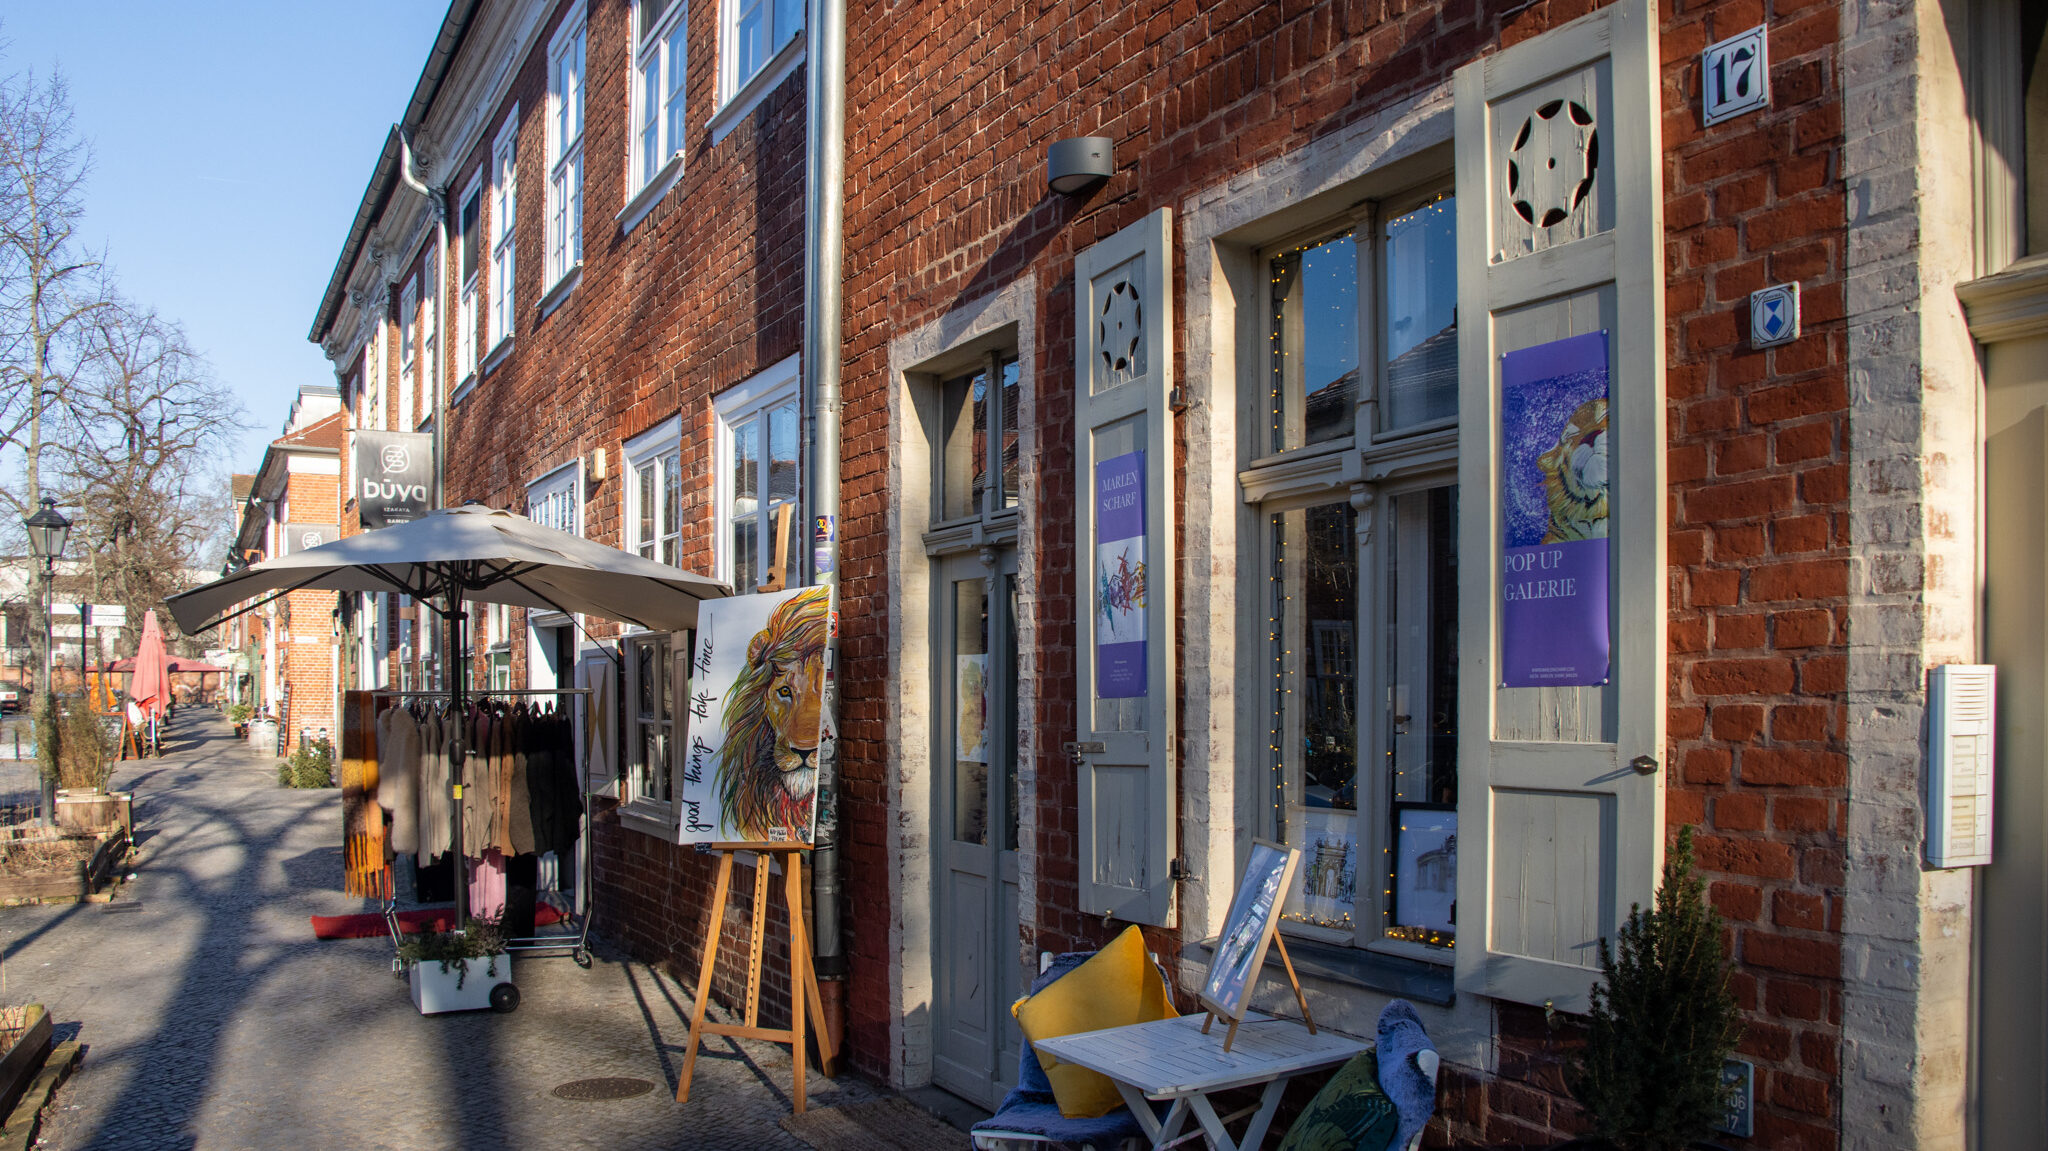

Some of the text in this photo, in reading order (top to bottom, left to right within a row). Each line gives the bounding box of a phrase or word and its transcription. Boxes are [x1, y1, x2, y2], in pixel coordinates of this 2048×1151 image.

[1711, 44, 1756, 108] 17
[1102, 470, 1138, 492] MARLEN
[1103, 491, 1137, 512] SCHARF
[1504, 550, 1563, 573] POP UP
[1504, 578, 1577, 602] GALERIE
[695, 612, 714, 681] time
[690, 688, 718, 723] take
[684, 735, 714, 786] things
[685, 800, 714, 833] good
